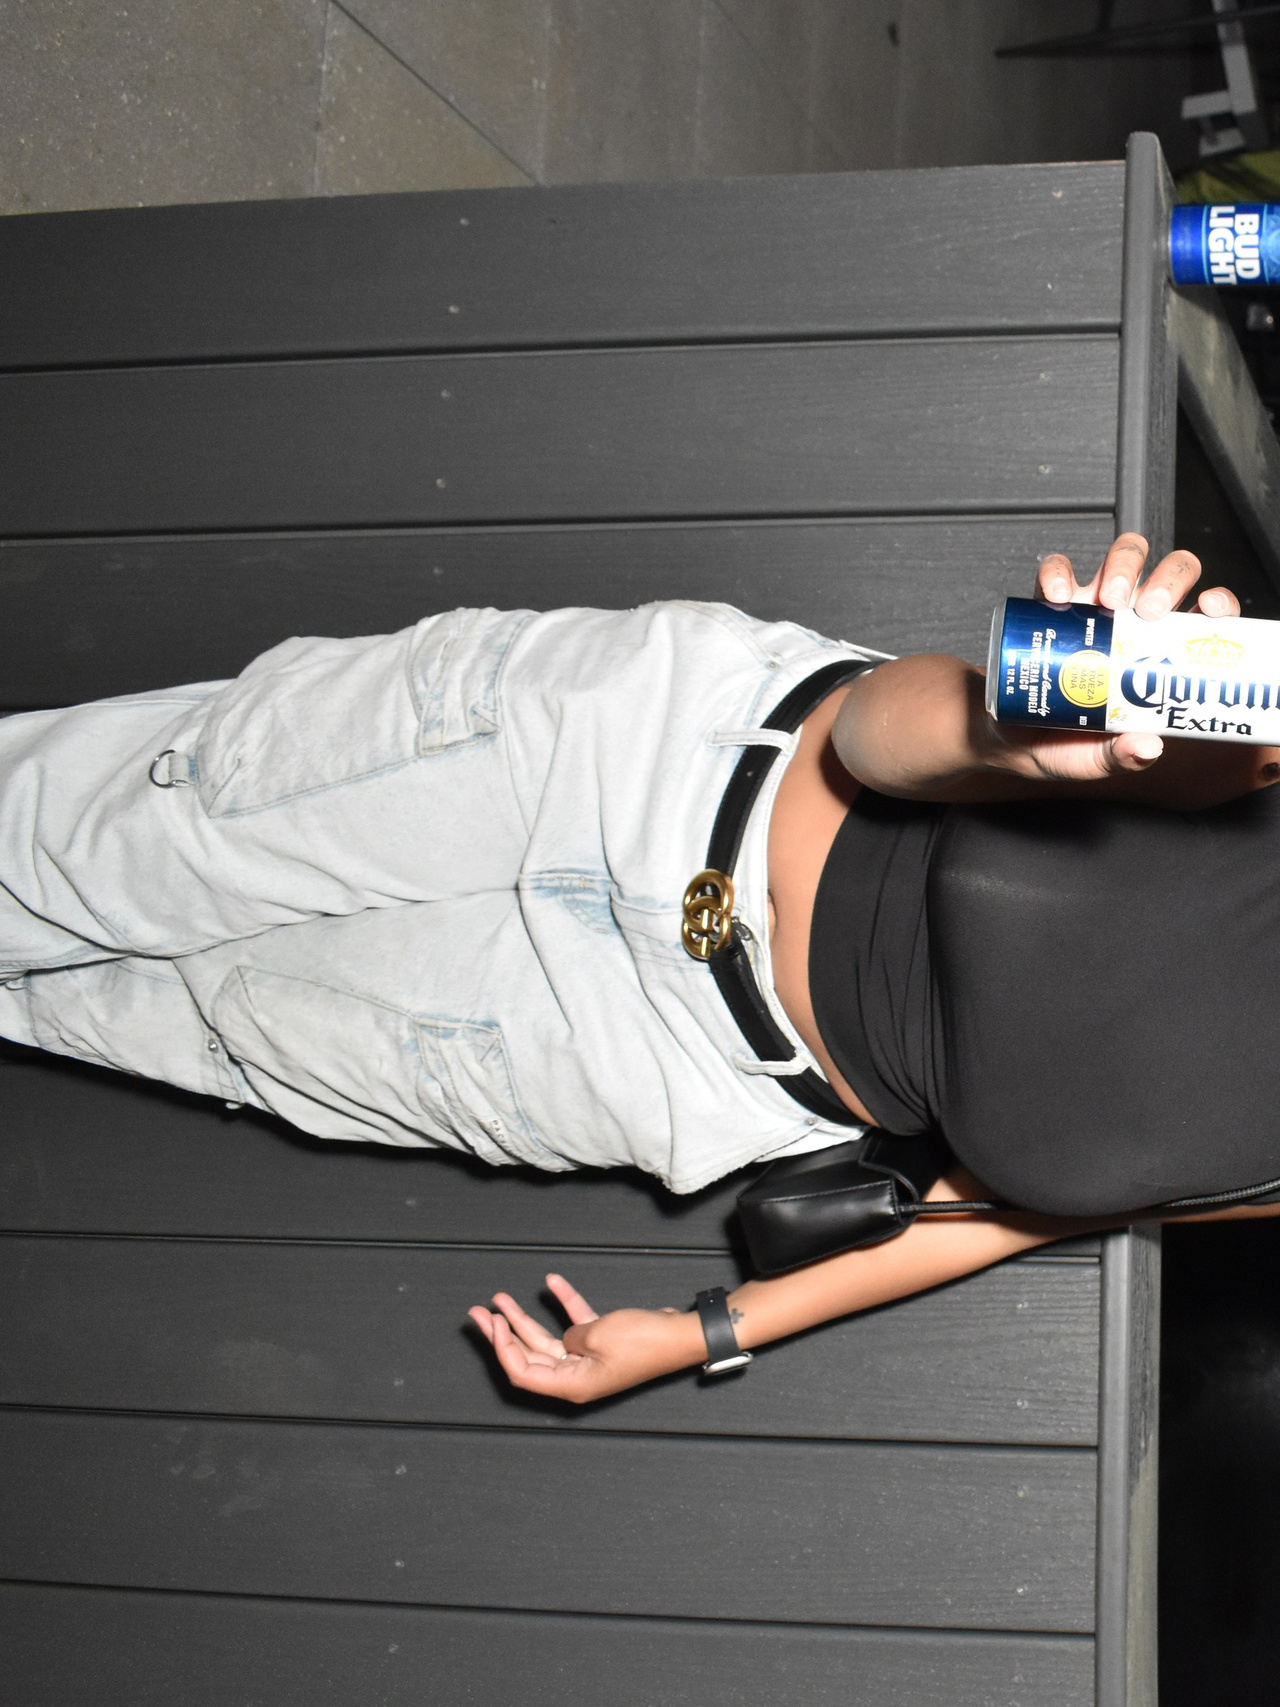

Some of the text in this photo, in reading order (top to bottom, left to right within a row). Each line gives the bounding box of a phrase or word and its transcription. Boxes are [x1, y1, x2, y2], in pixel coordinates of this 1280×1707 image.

[1208, 205, 1238, 285] LIGHT
[1233, 213, 1261, 280] BUD
[1028, 631, 1043, 714] CERVCERIA MODELO
[1087, 669, 1096, 701] RVEZA
[1166, 706, 1253, 736] Extra
